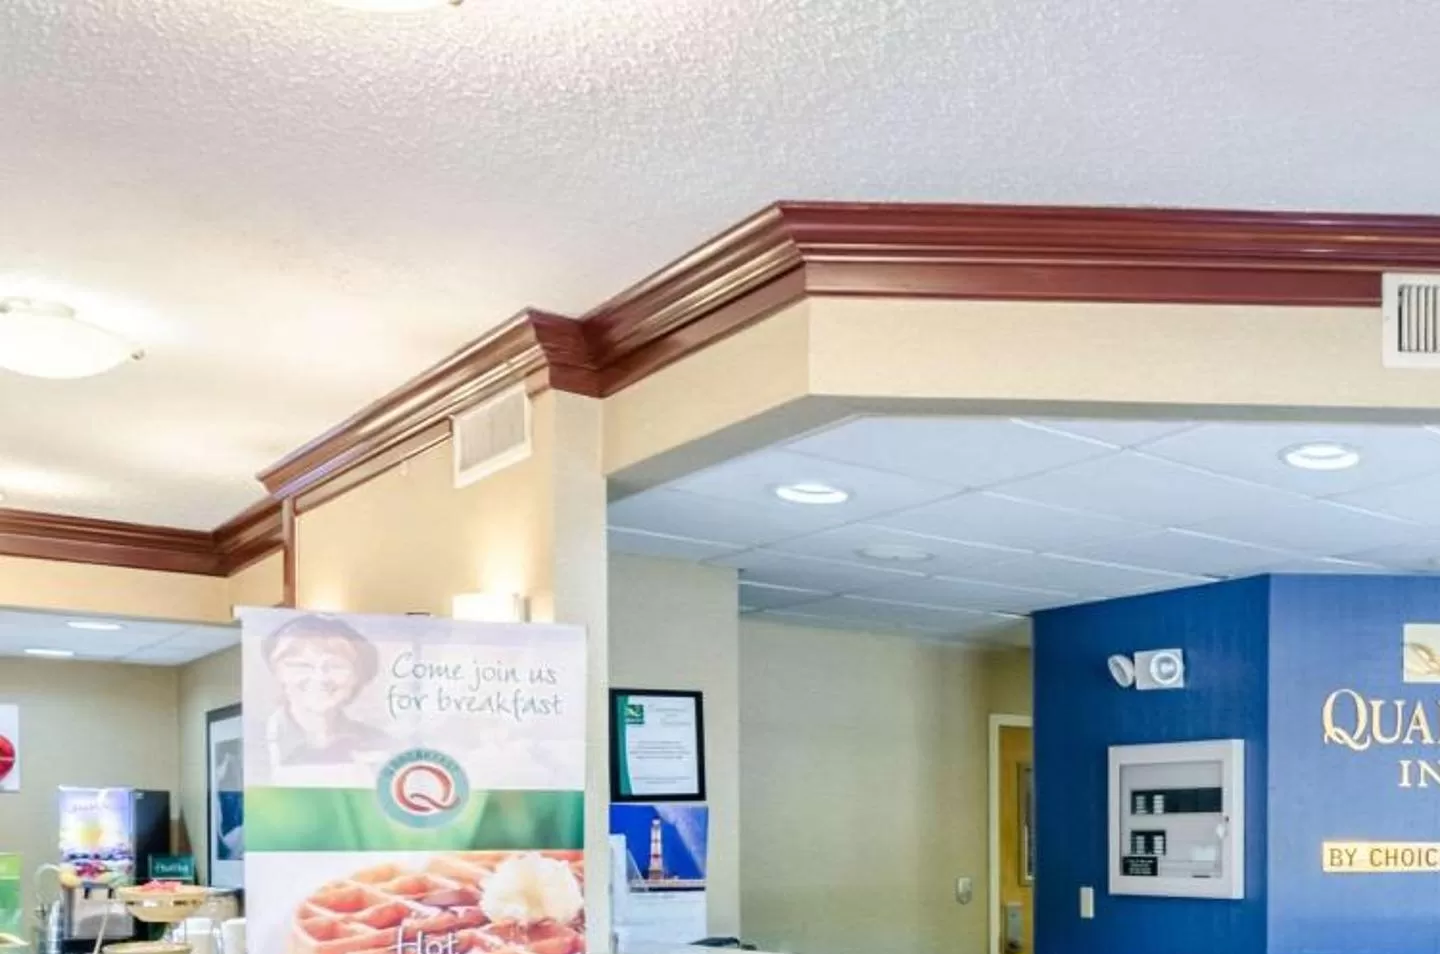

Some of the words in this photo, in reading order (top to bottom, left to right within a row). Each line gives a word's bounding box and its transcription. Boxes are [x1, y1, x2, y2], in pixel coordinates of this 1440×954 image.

[391, 651, 464, 680] Come
[468, 660, 521, 692] join
[528, 667, 557, 685] us
[387, 684, 428, 720] for
[437, 687, 564, 723] breakfast
[1329, 847, 1358, 868] BY
